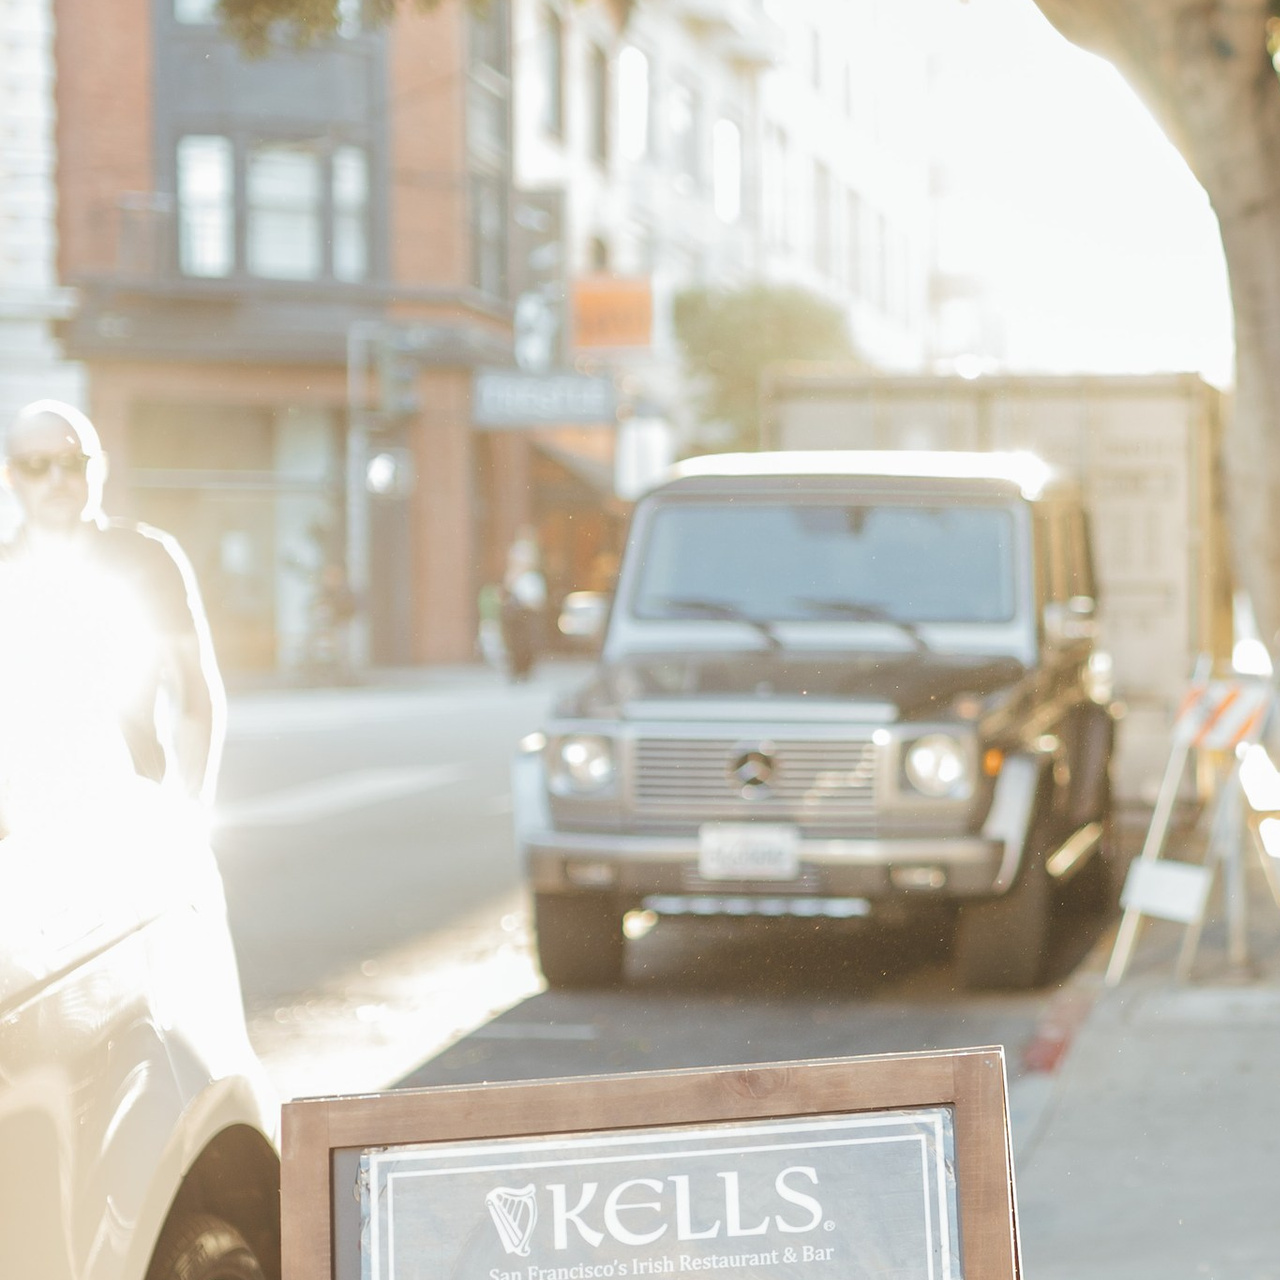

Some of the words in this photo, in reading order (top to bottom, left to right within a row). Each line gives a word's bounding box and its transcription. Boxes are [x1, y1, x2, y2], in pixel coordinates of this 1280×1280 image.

[632, 1255, 674, 1275] Irish
[679, 1249, 779, 1271] Restaurant
[782, 1246, 798, 1263] &
[802, 1245, 835, 1262] Bar
